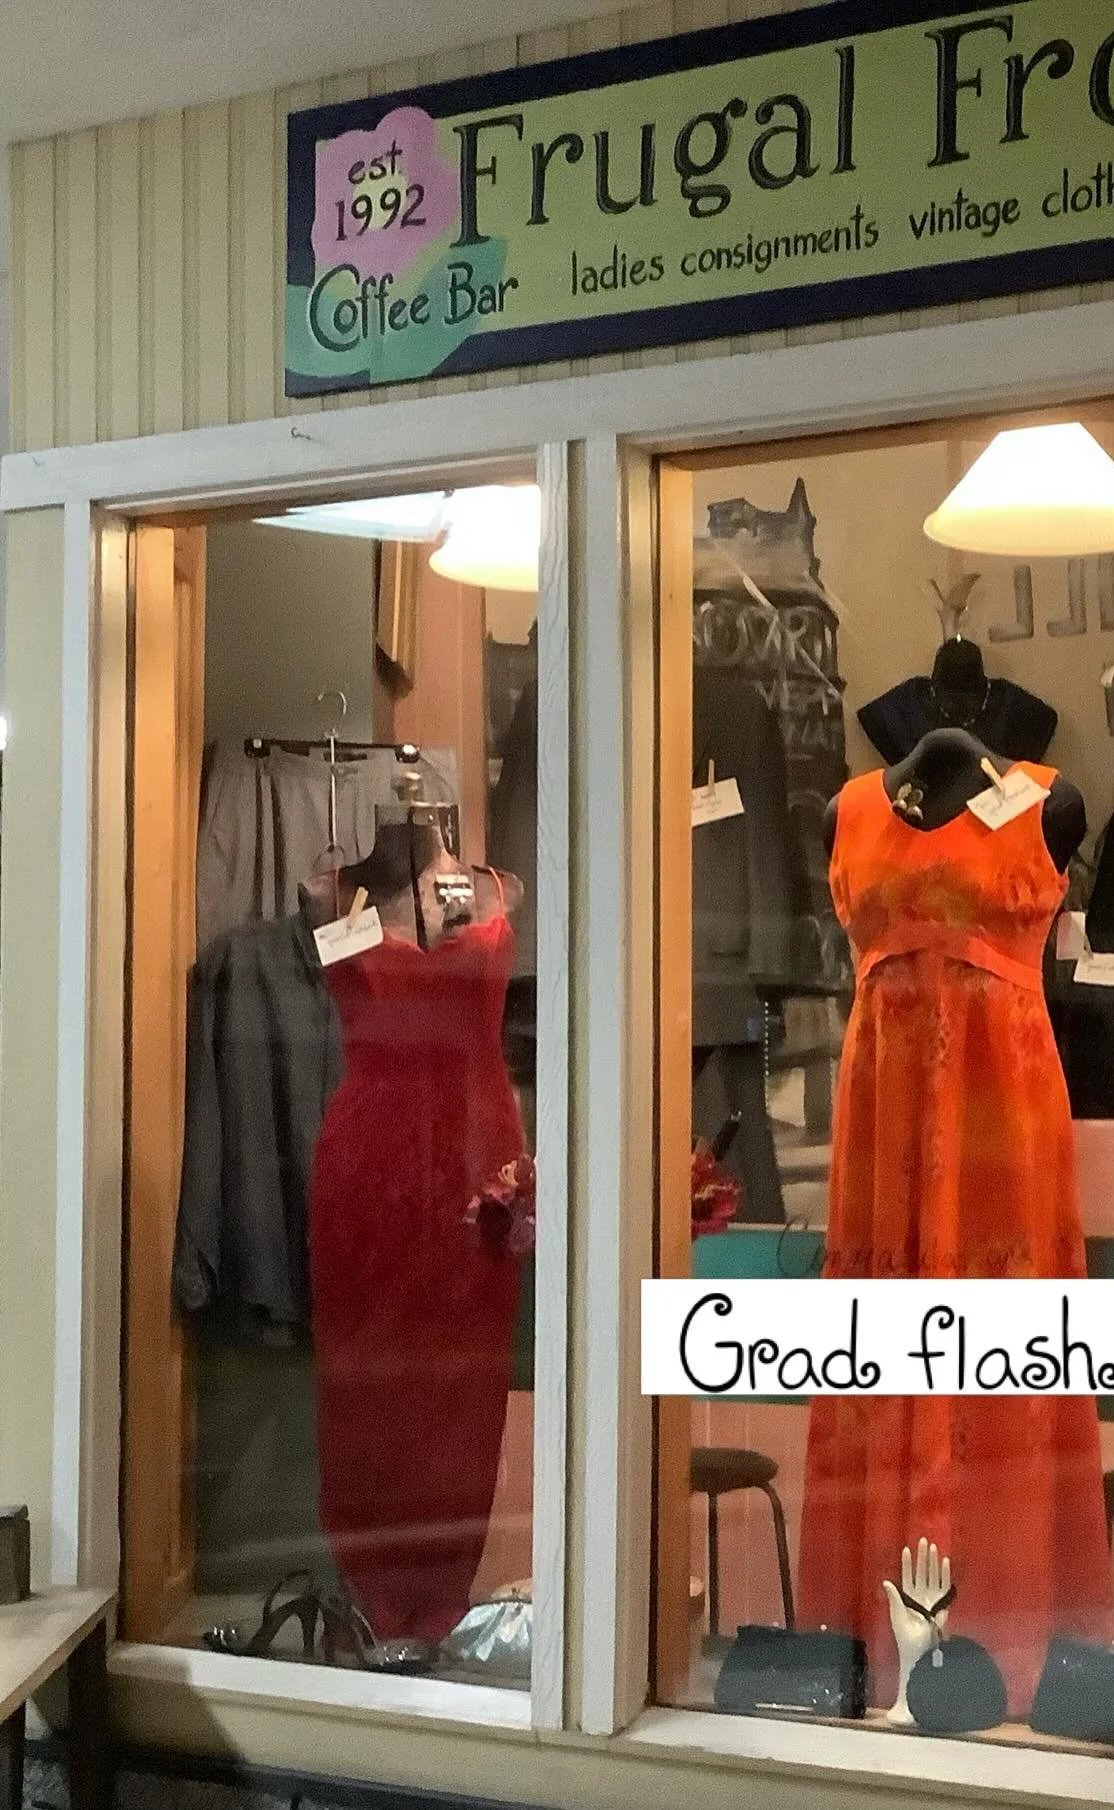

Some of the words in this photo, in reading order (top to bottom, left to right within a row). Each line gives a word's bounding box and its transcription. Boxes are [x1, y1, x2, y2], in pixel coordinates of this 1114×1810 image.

[449, 43, 857, 248] Frugal
[334, 186, 425, 241] 1992
[570, 244, 665, 295] ladies
[680, 204, 880, 277] consignments
[909, 188, 1021, 240] vintage
[308, 265, 429, 352] Coffee
[443, 262, 518, 324] Bar
